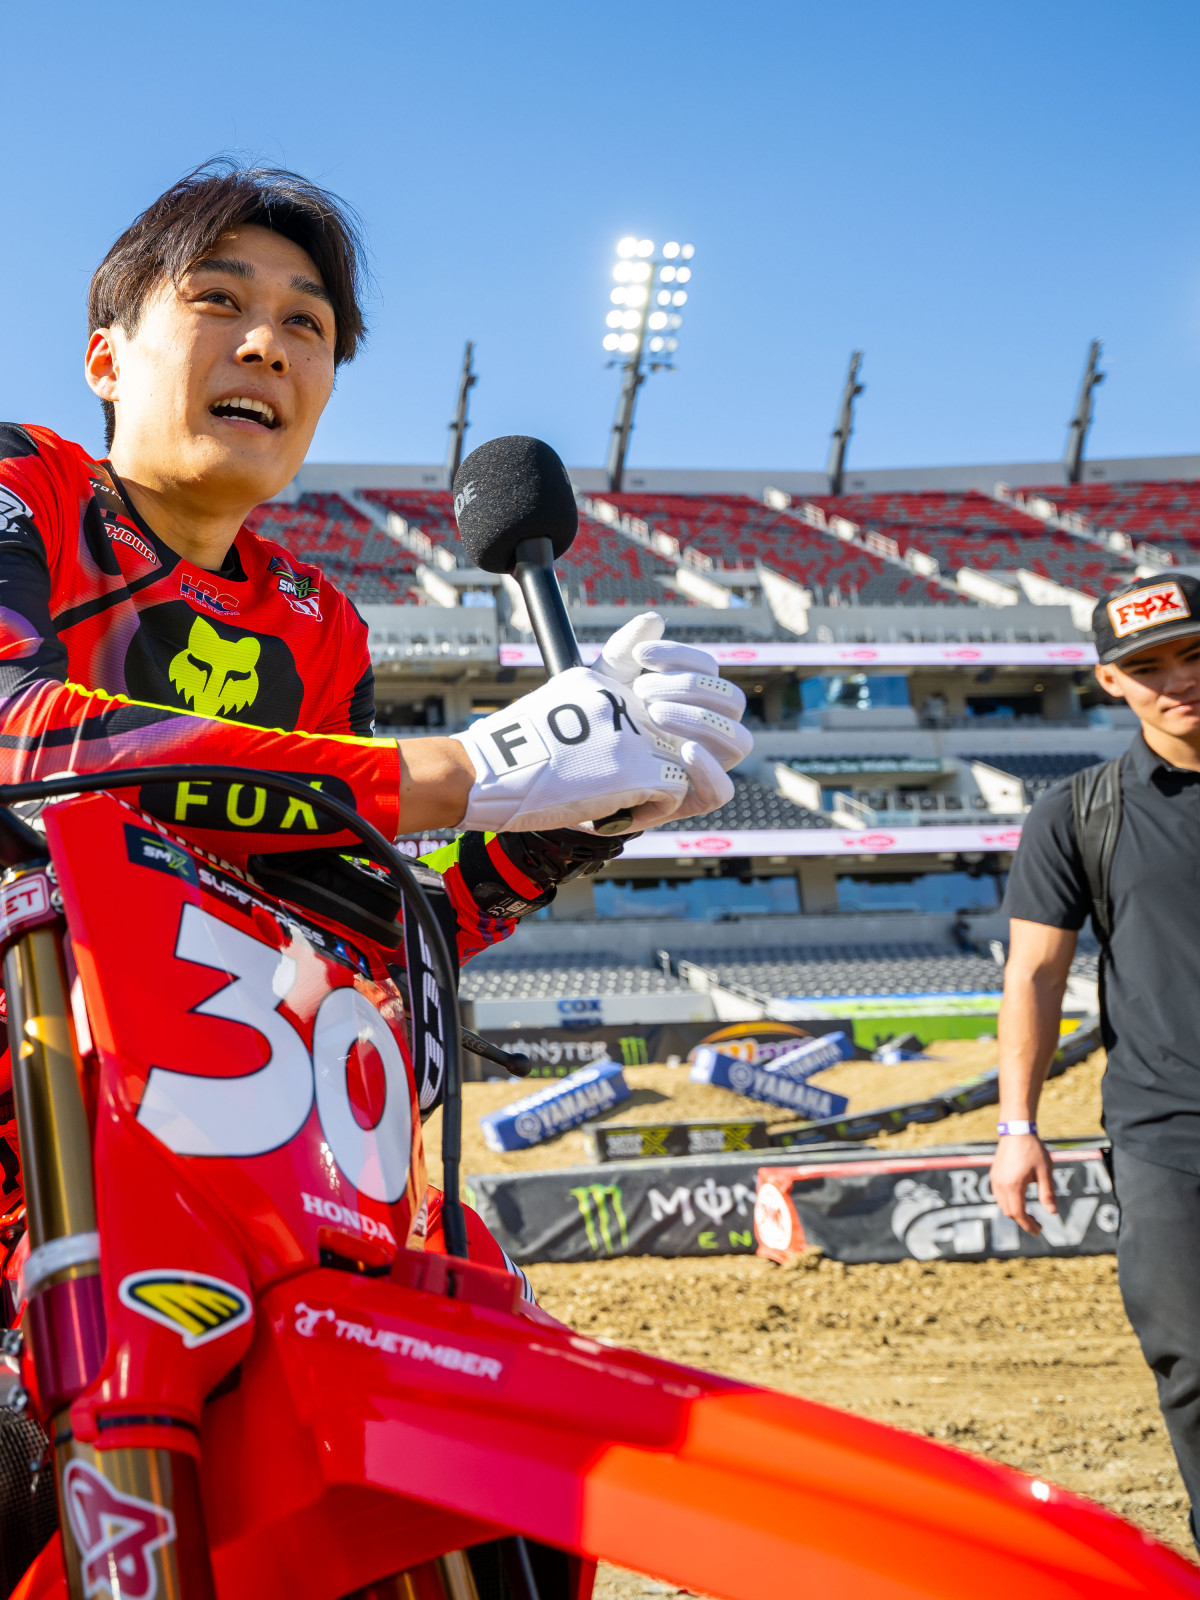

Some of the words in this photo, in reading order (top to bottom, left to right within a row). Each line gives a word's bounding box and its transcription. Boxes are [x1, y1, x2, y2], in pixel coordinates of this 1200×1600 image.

[180, 573, 240, 612] HRC
[490, 689, 641, 768] FOX
[174, 781, 322, 830] FOX
[136, 902, 411, 1204] 30
[461, 1031, 489, 1052] RC
[535, 1078, 617, 1130] YAMAHA
[948, 1167, 1076, 1205] ROY
[300, 1191, 398, 1250] HONDA
[335, 1319, 503, 1381] TRUETIMBER
